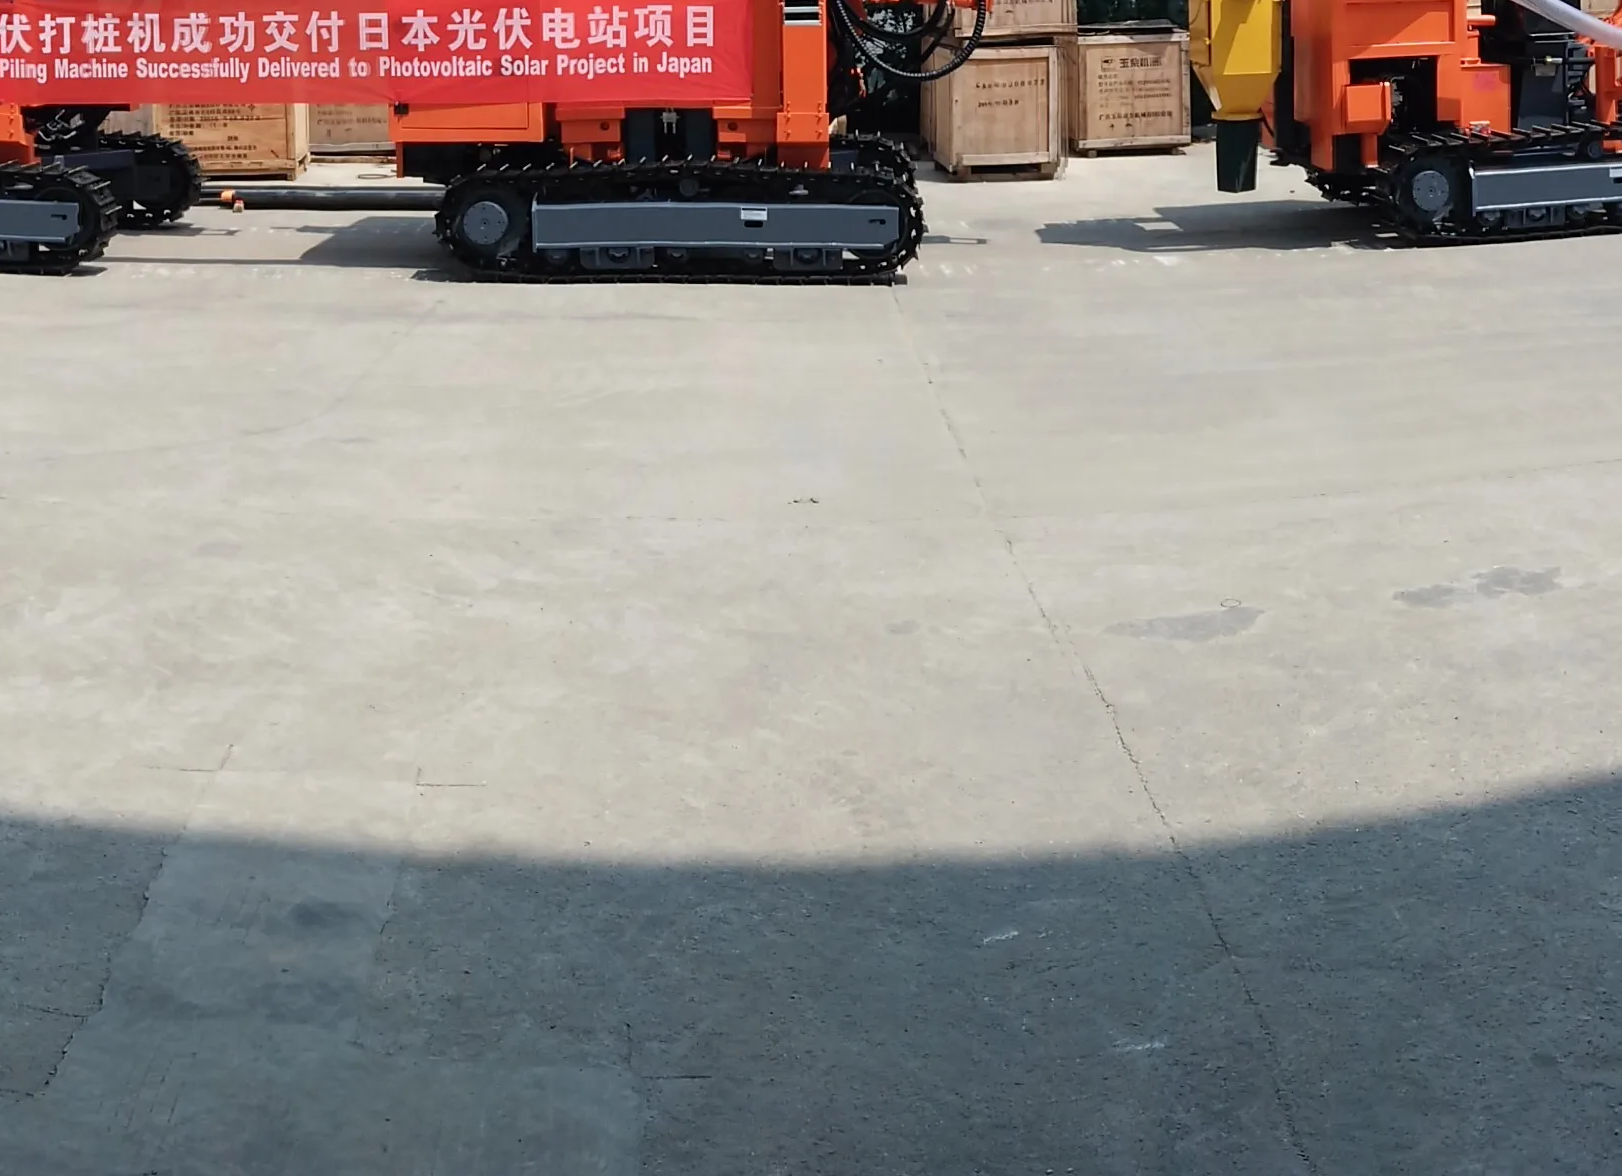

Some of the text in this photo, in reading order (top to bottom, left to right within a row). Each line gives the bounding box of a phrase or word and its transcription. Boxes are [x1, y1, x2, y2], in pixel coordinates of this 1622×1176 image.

[0, 58, 48, 84] Piling
[54, 57, 129, 79] Machine
[135, 56, 251, 84] Successfully
[257, 56, 340, 78] Delivered
[347, 57, 371, 78] to
[378, 55, 493, 78] Photovoltaic
[500, 54, 549, 76] Solar
[556, 52, 626, 80] Project
[632, 51, 649, 73] in
[656, 51, 713, 79] Japan
